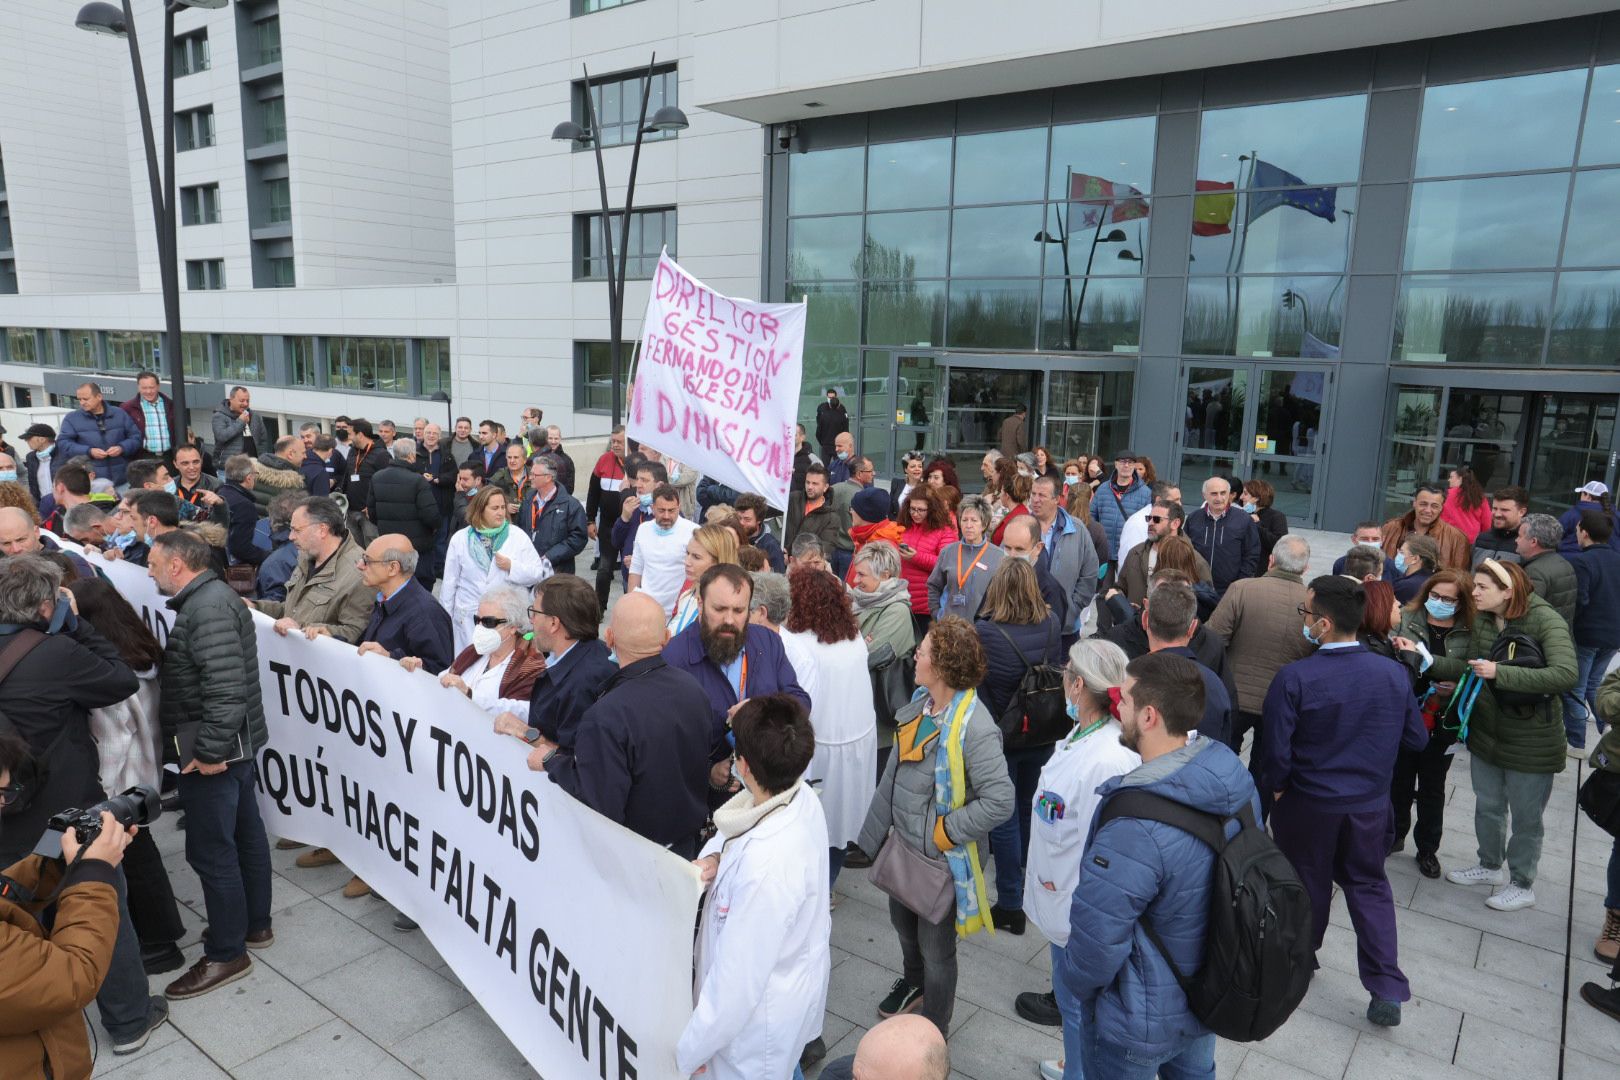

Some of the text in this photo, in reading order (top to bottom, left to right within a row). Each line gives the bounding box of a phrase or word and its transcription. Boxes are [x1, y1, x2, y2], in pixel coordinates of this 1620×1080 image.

[645, 333, 741, 387] FERNANDO
[683, 372, 761, 420] IGLESIA
[269, 660, 540, 863] TODOS Y TODAS
[340, 774, 420, 877] HACE
[430, 830, 518, 975] FALTA
[528, 927, 638, 1080] GENTE
